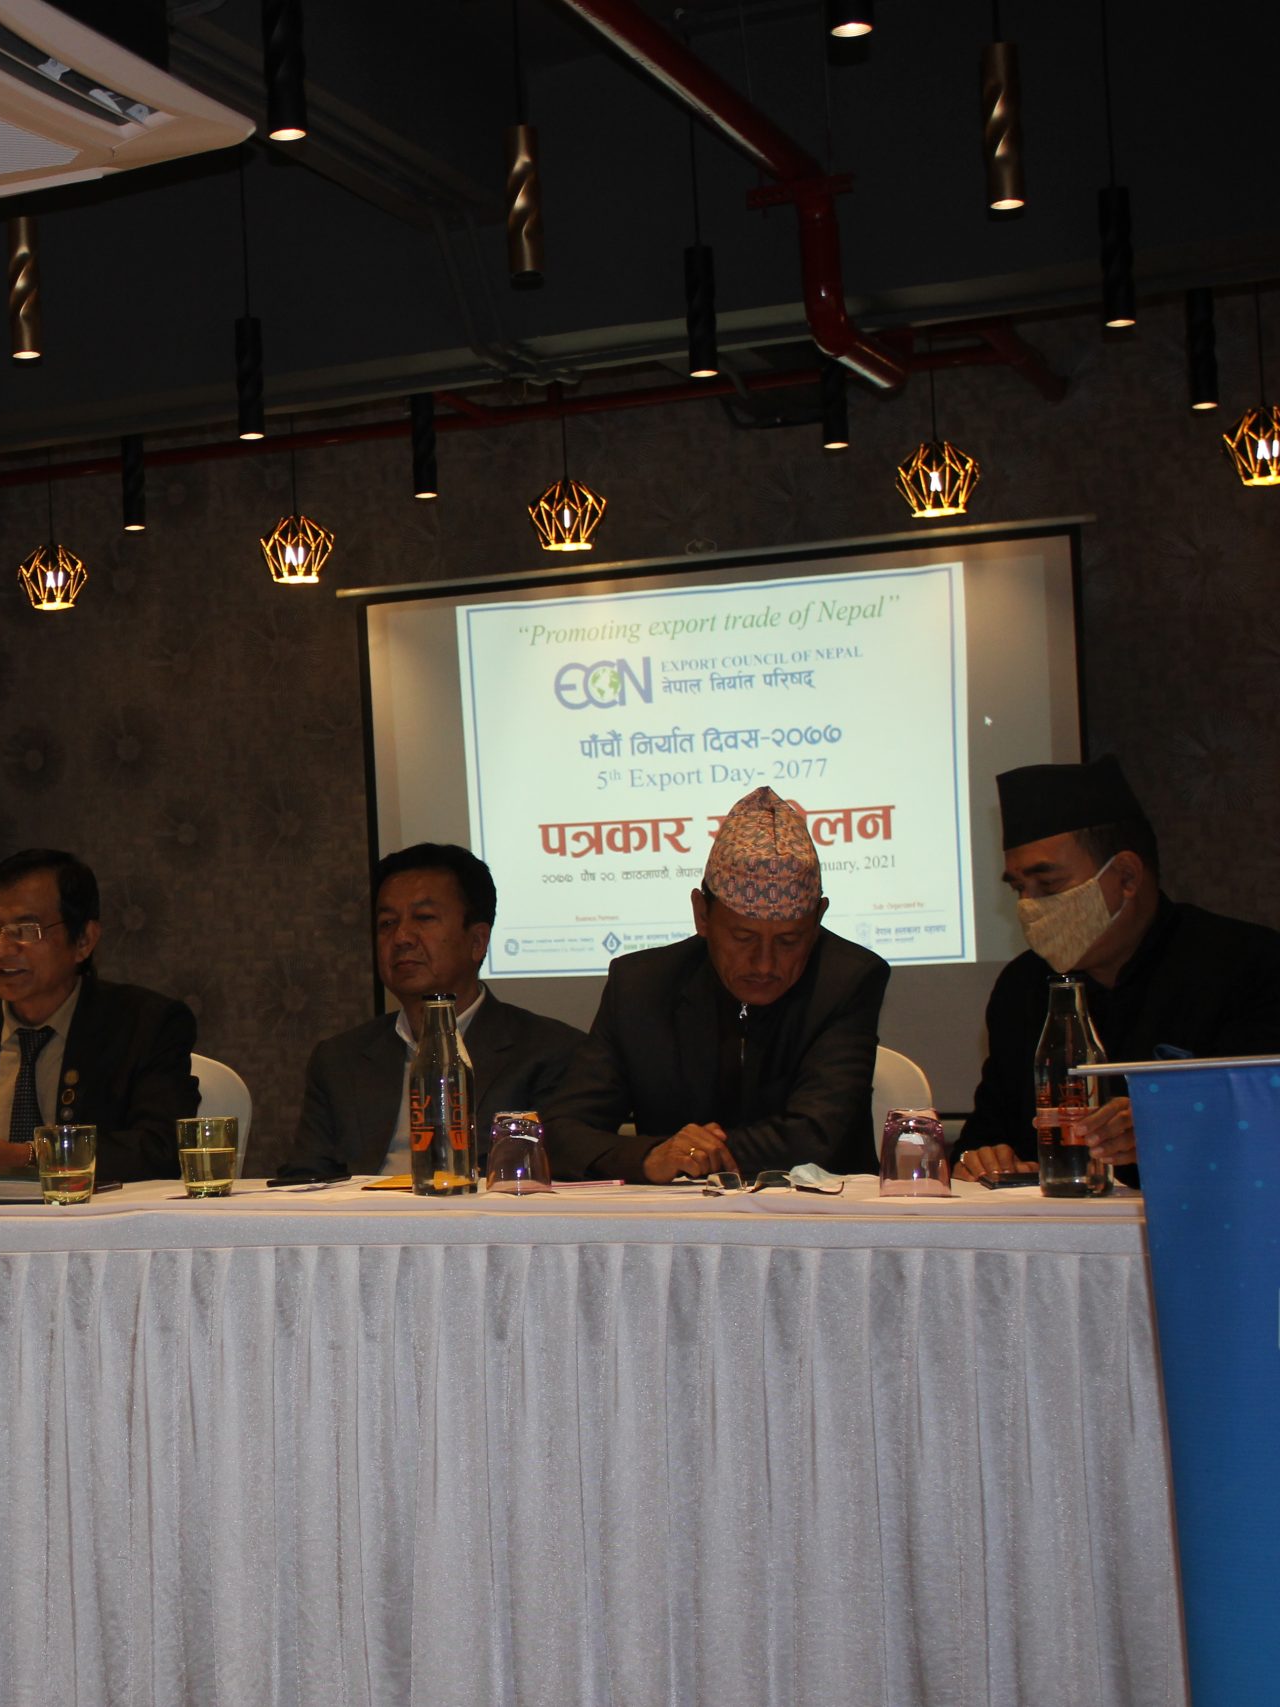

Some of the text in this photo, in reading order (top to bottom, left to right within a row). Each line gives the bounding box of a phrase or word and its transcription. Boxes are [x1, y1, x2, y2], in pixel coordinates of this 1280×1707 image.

[649, 613, 717, 641] export
[724, 605, 782, 632] trade
[789, 600, 816, 631] of
[661, 645, 863, 673] EXPORT COUNCIL OF NEPAL
[554, 656, 654, 710] ECN
[662, 675, 703, 695] नेपाल
[630, 725, 696, 757] निर्यात
[596, 767, 622, 791] 5th
[629, 766, 704, 792] Export
[773, 757, 829, 781] 2077
[538, 816, 694, 859] पत्रकार
[820, 853, 897, 874] nuary, 2021
